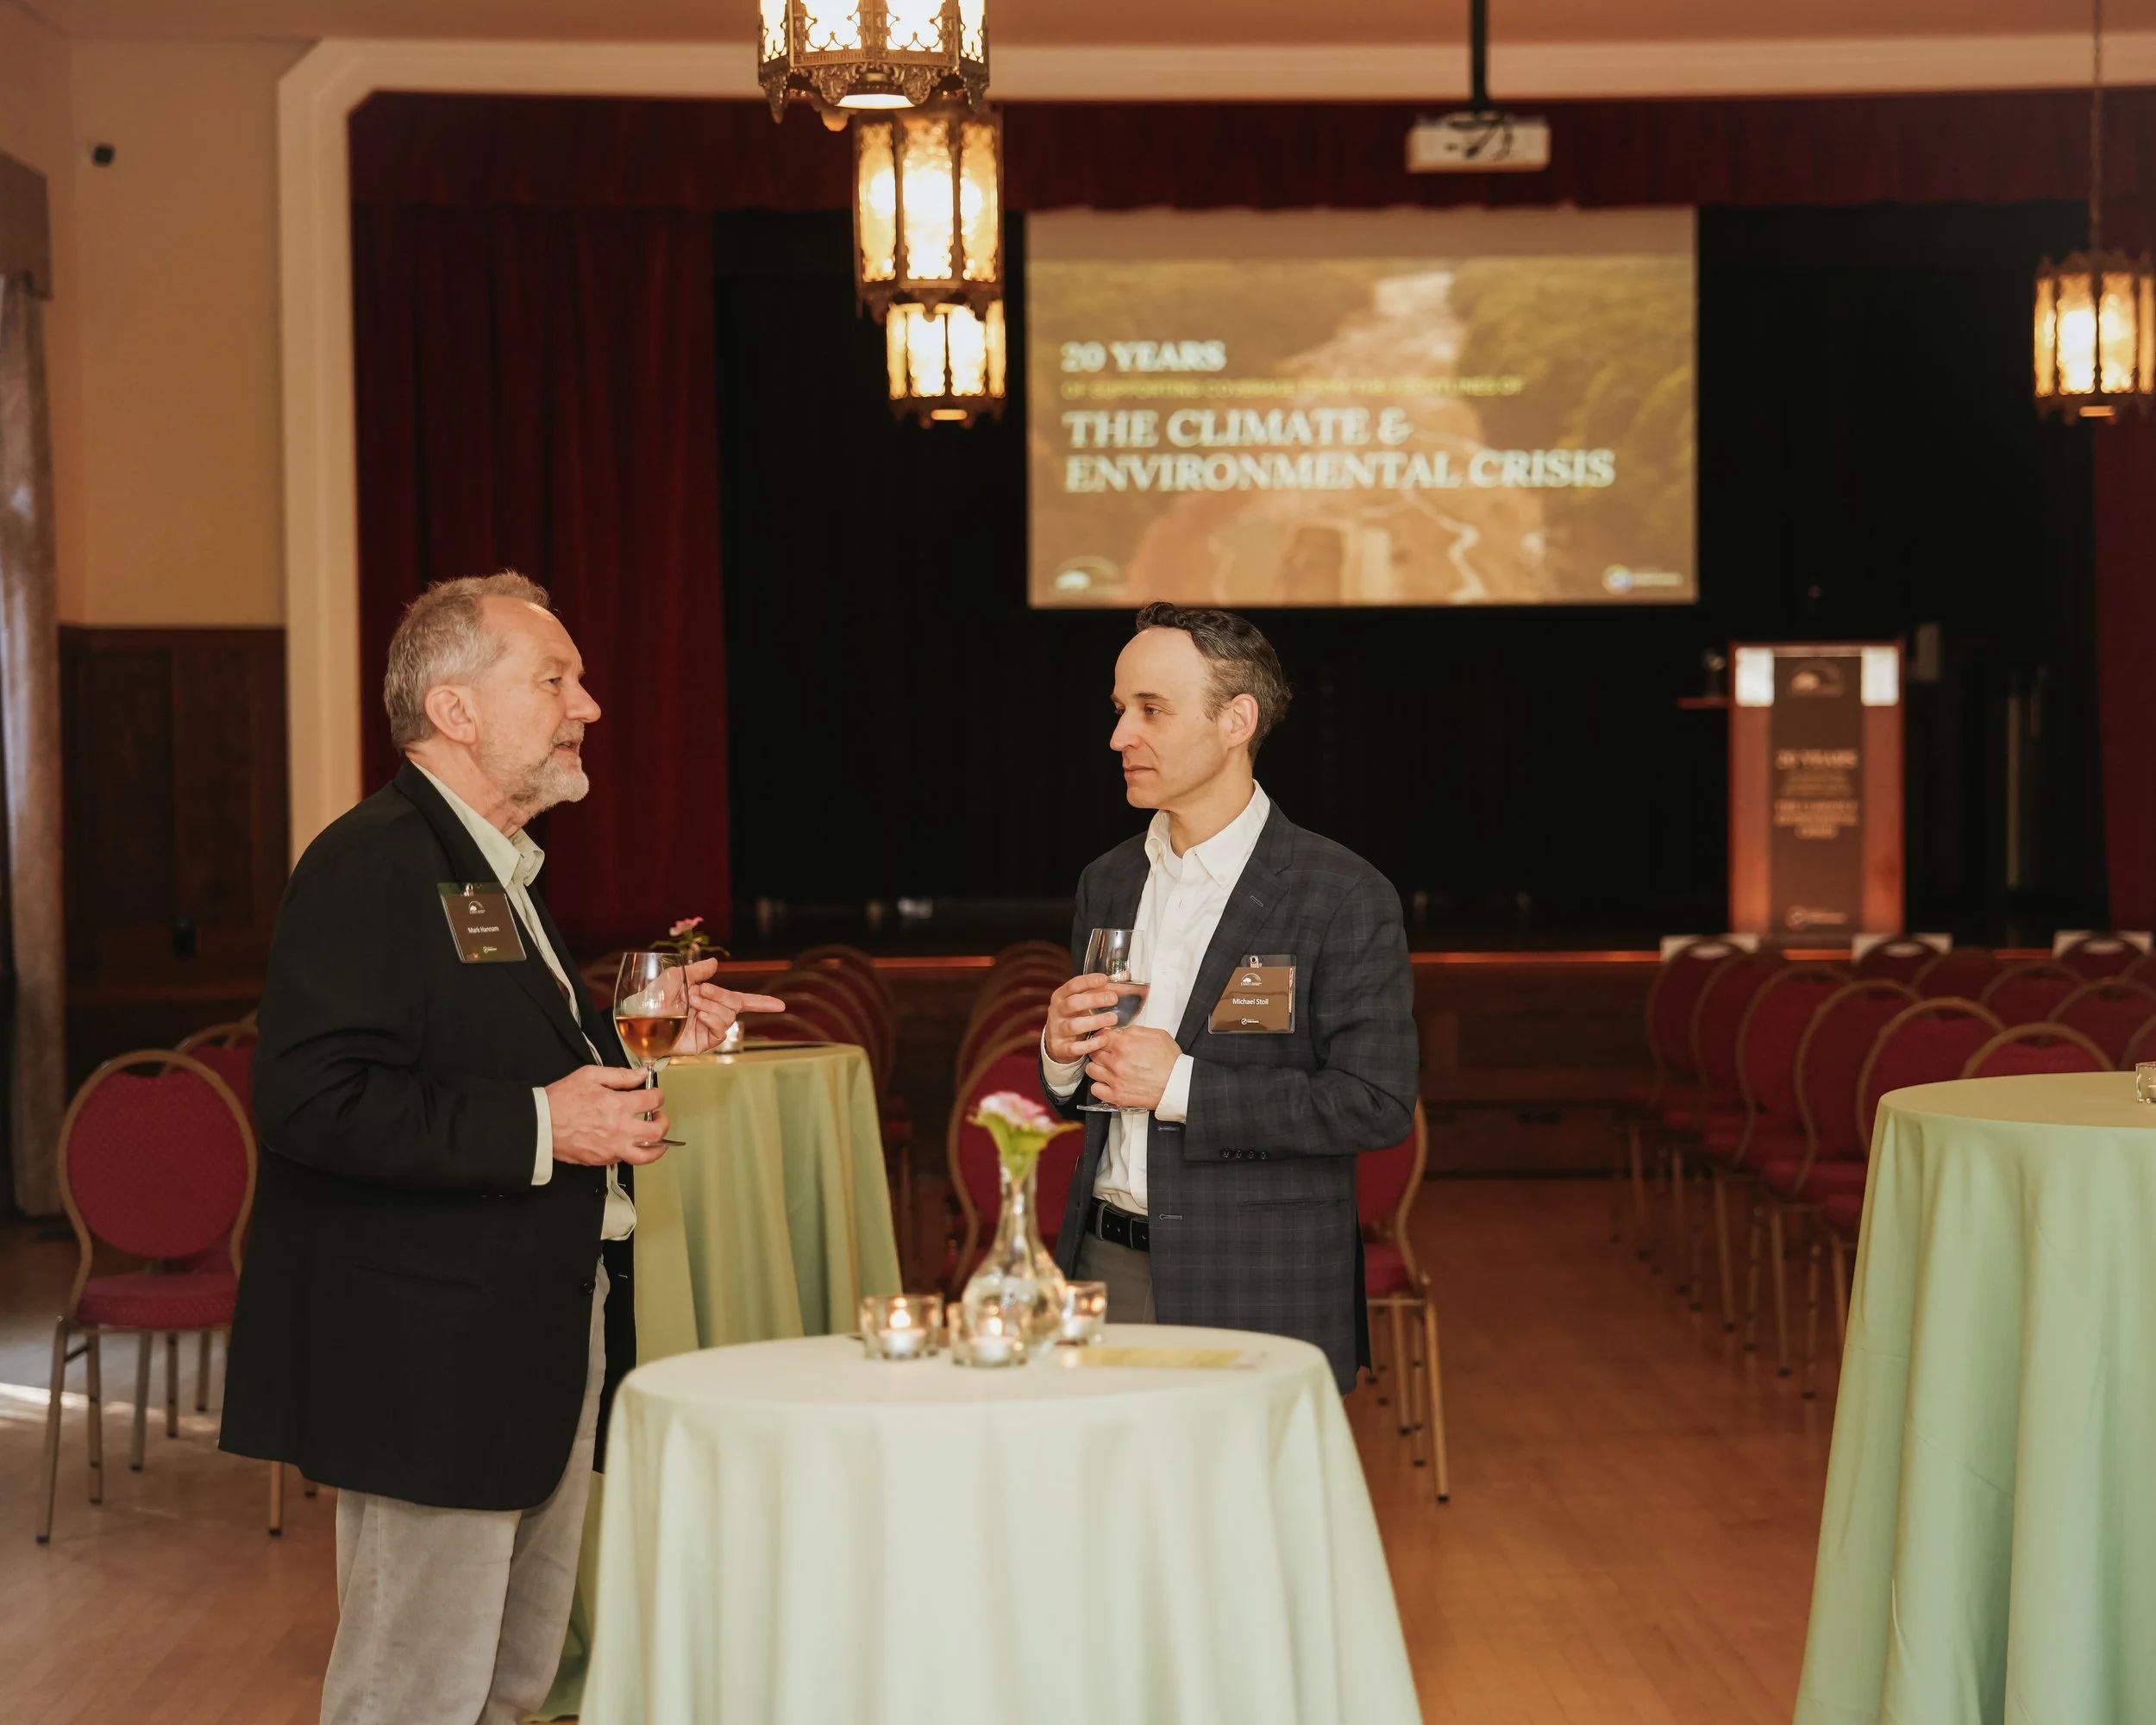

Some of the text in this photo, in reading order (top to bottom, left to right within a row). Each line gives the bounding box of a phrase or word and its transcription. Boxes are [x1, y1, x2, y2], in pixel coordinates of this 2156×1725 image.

[1061, 340, 1226, 372] 20 YEARS
[1062, 406, 1413, 447] THE CLIMATE &
[1066, 448, 1616, 492] ENVIRONMENTAL CRISIS
